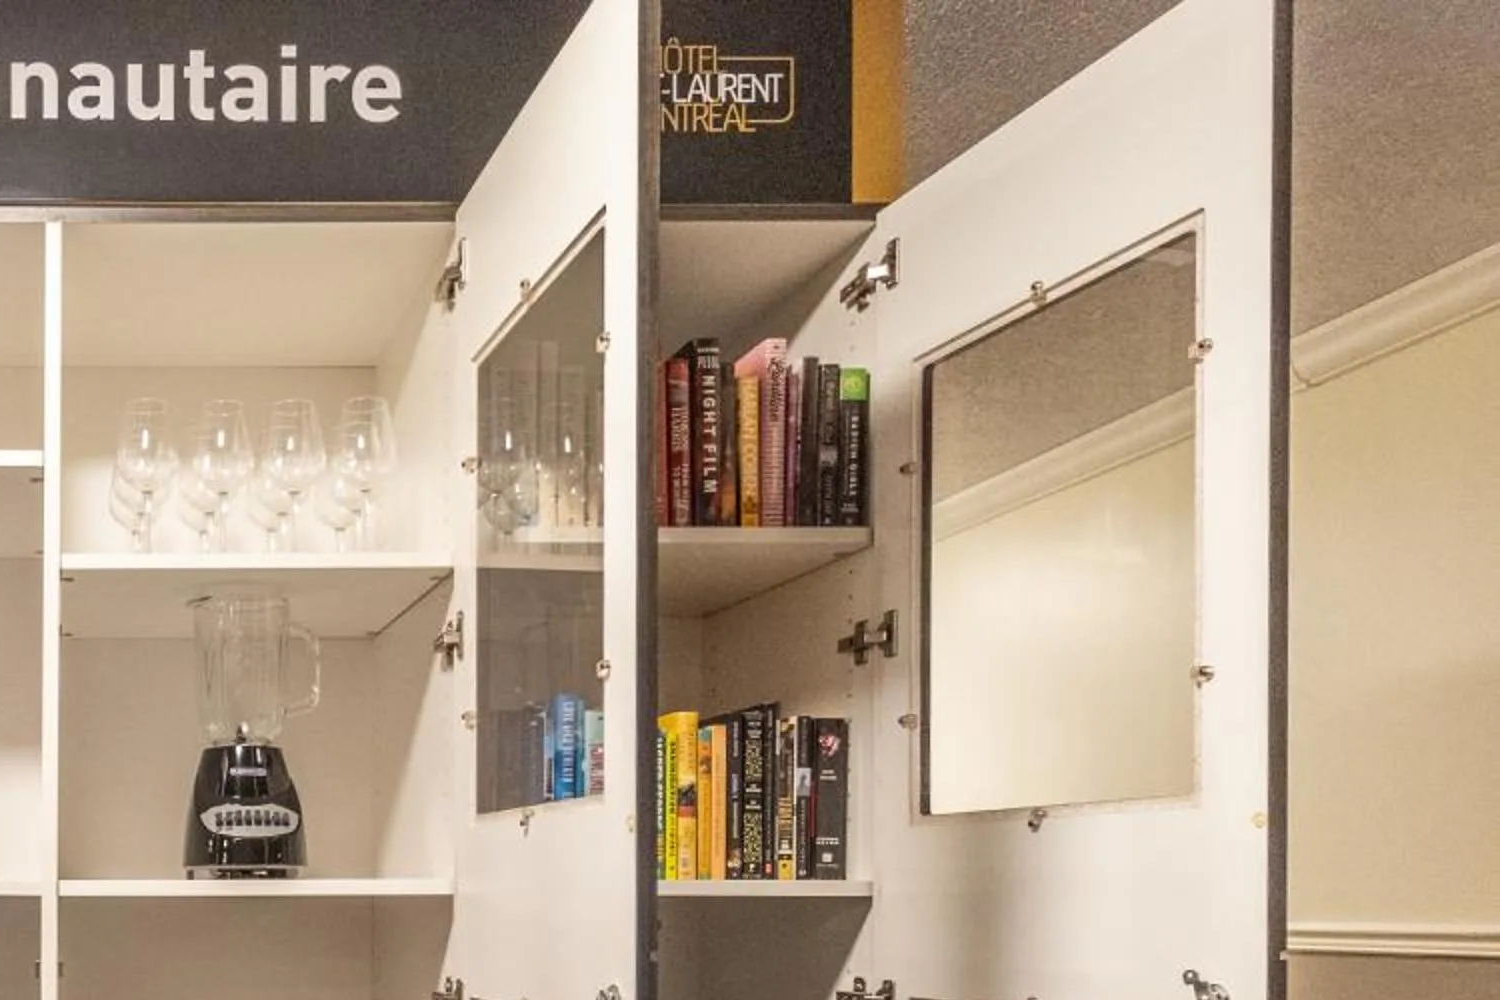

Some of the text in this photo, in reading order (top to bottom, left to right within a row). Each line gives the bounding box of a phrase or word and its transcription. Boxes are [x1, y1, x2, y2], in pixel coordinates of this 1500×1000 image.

[659, 36, 727, 74] ÔTEL
[660, 72, 784, 103] -LAURENT
[702, 374, 717, 437] NIGHT
[702, 445, 717, 494] FILM
